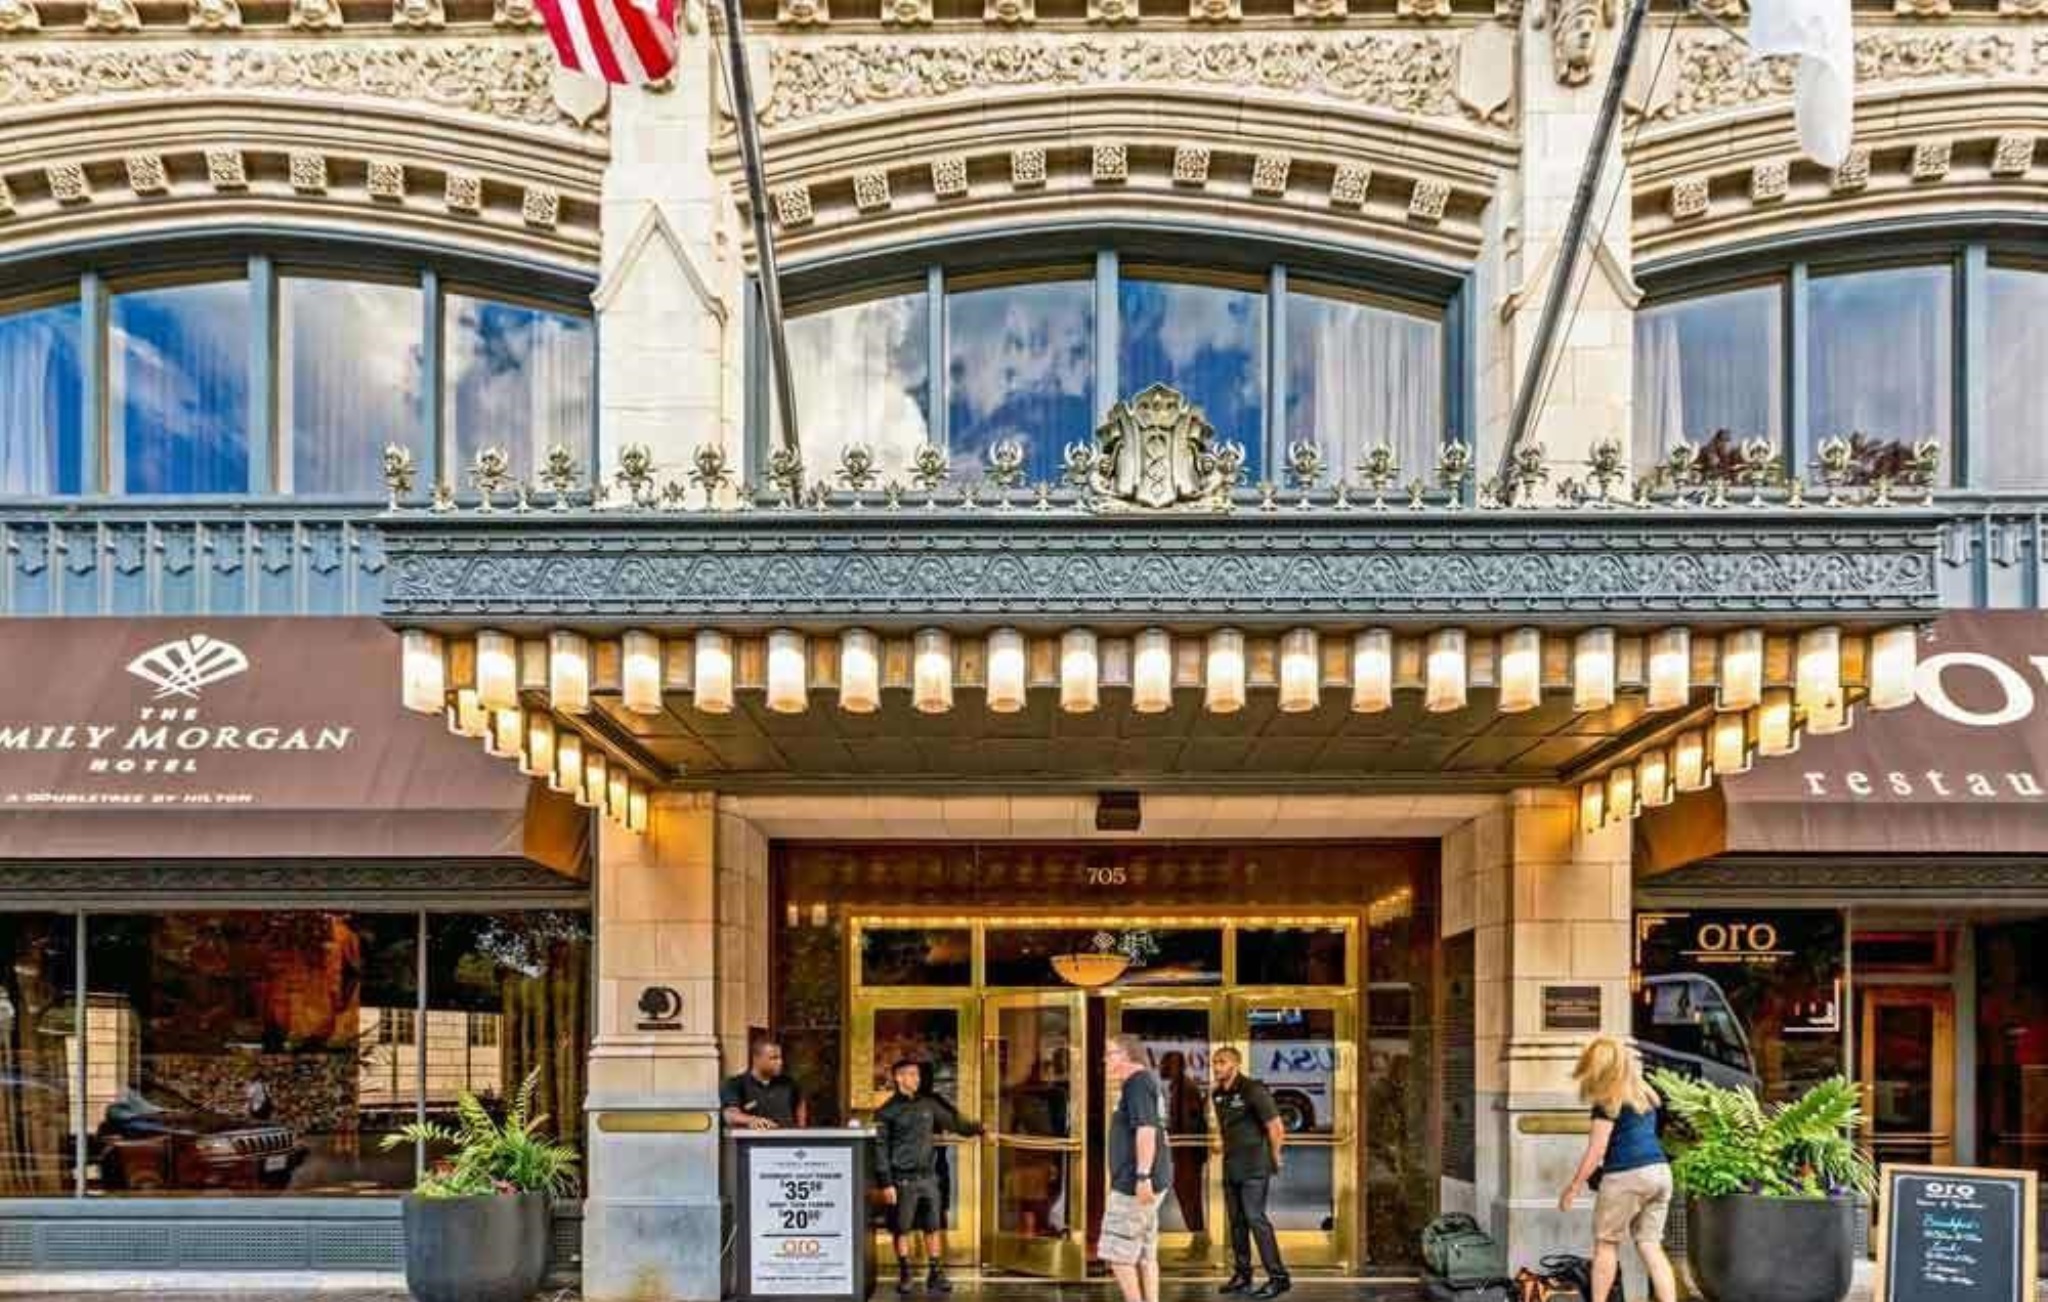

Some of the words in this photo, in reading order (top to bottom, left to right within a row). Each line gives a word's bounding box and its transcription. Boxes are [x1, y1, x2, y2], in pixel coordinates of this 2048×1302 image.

[1914, 652, 2048, 726] o
[140, 707, 197, 721] THE
[0, 726, 115, 749] MILY
[124, 725, 352, 750] MORGAN
[89, 758, 197, 772] HOTEL
[1804, 768, 2043, 796] restau
[1086, 867, 1127, 885] 705
[1697, 923, 1777, 951] oro
